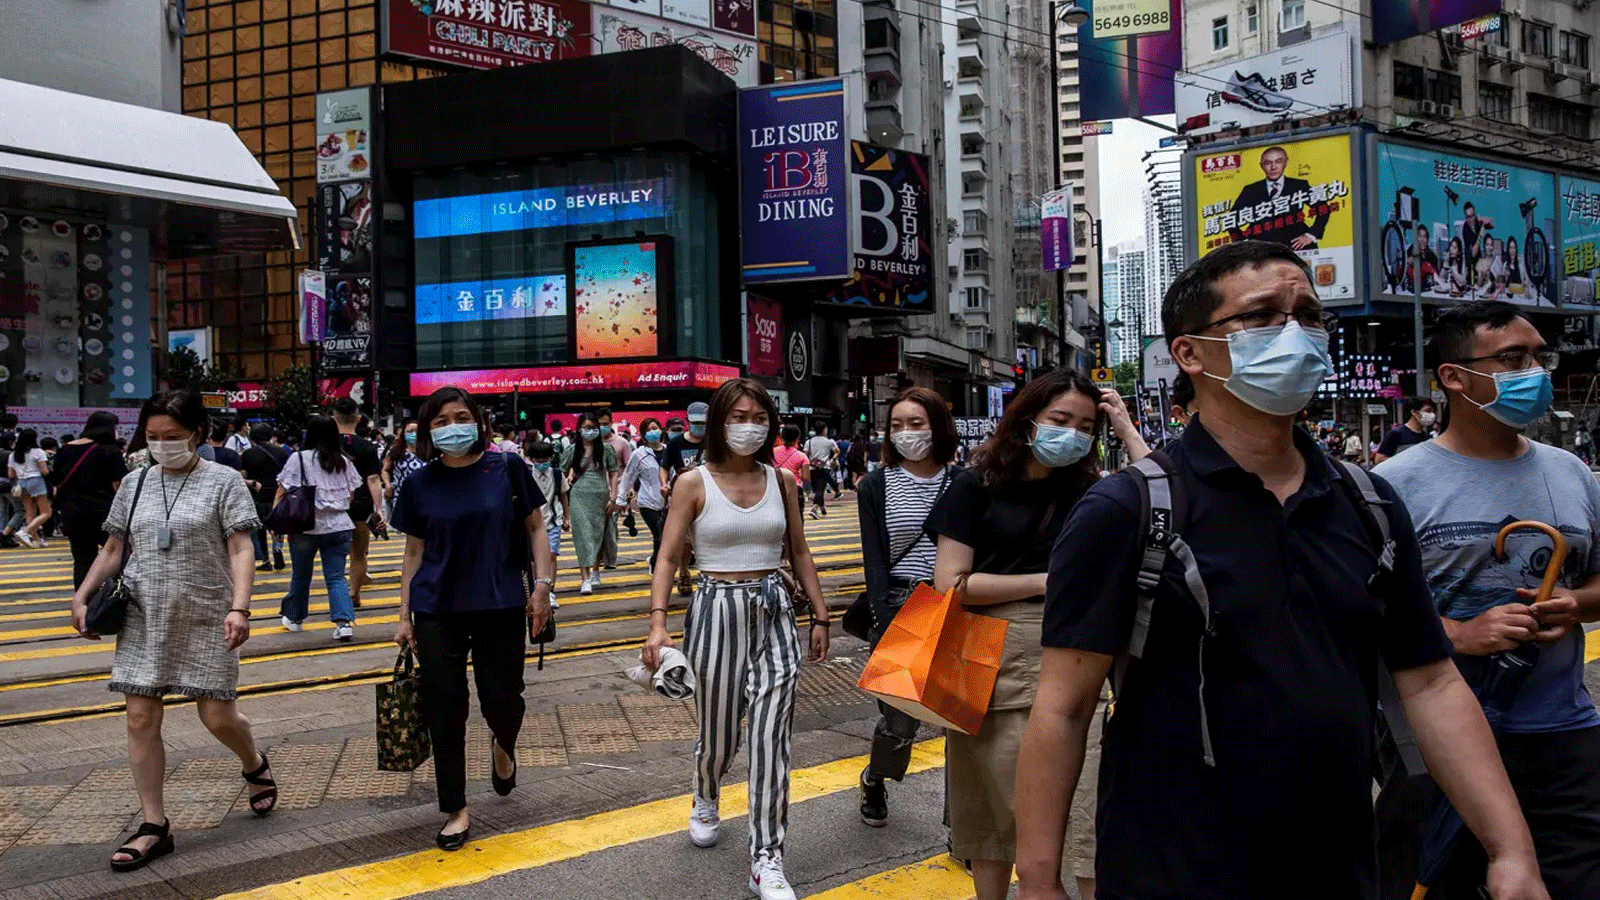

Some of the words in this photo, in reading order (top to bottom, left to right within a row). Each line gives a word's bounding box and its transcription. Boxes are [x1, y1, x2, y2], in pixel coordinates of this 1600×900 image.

[1095, 15, 1130, 31] 5649
[1132, 11, 1169, 26] 6988
[435, 20, 489, 48] CHILI
[492, 31, 555, 60] PARTY
[733, 43, 755, 58] 4/F
[750, 121, 839, 148] LEISURE
[493, 198, 556, 216] ISLAND
[566, 188, 653, 209] BEVERLEY
[758, 197, 835, 222] DINING
[1203, 179, 1349, 238] 馬百良安宮牛黃丸
[897, 182, 920, 262] 金百利
[870, 260, 921, 275] BEVERLEY
[1564, 242, 1600, 276] 香港
[456, 286, 533, 312] 金百利
[471, 375, 605, 389] www.islandbeverley.com.hk
[637, 374, 653, 383] Ad
